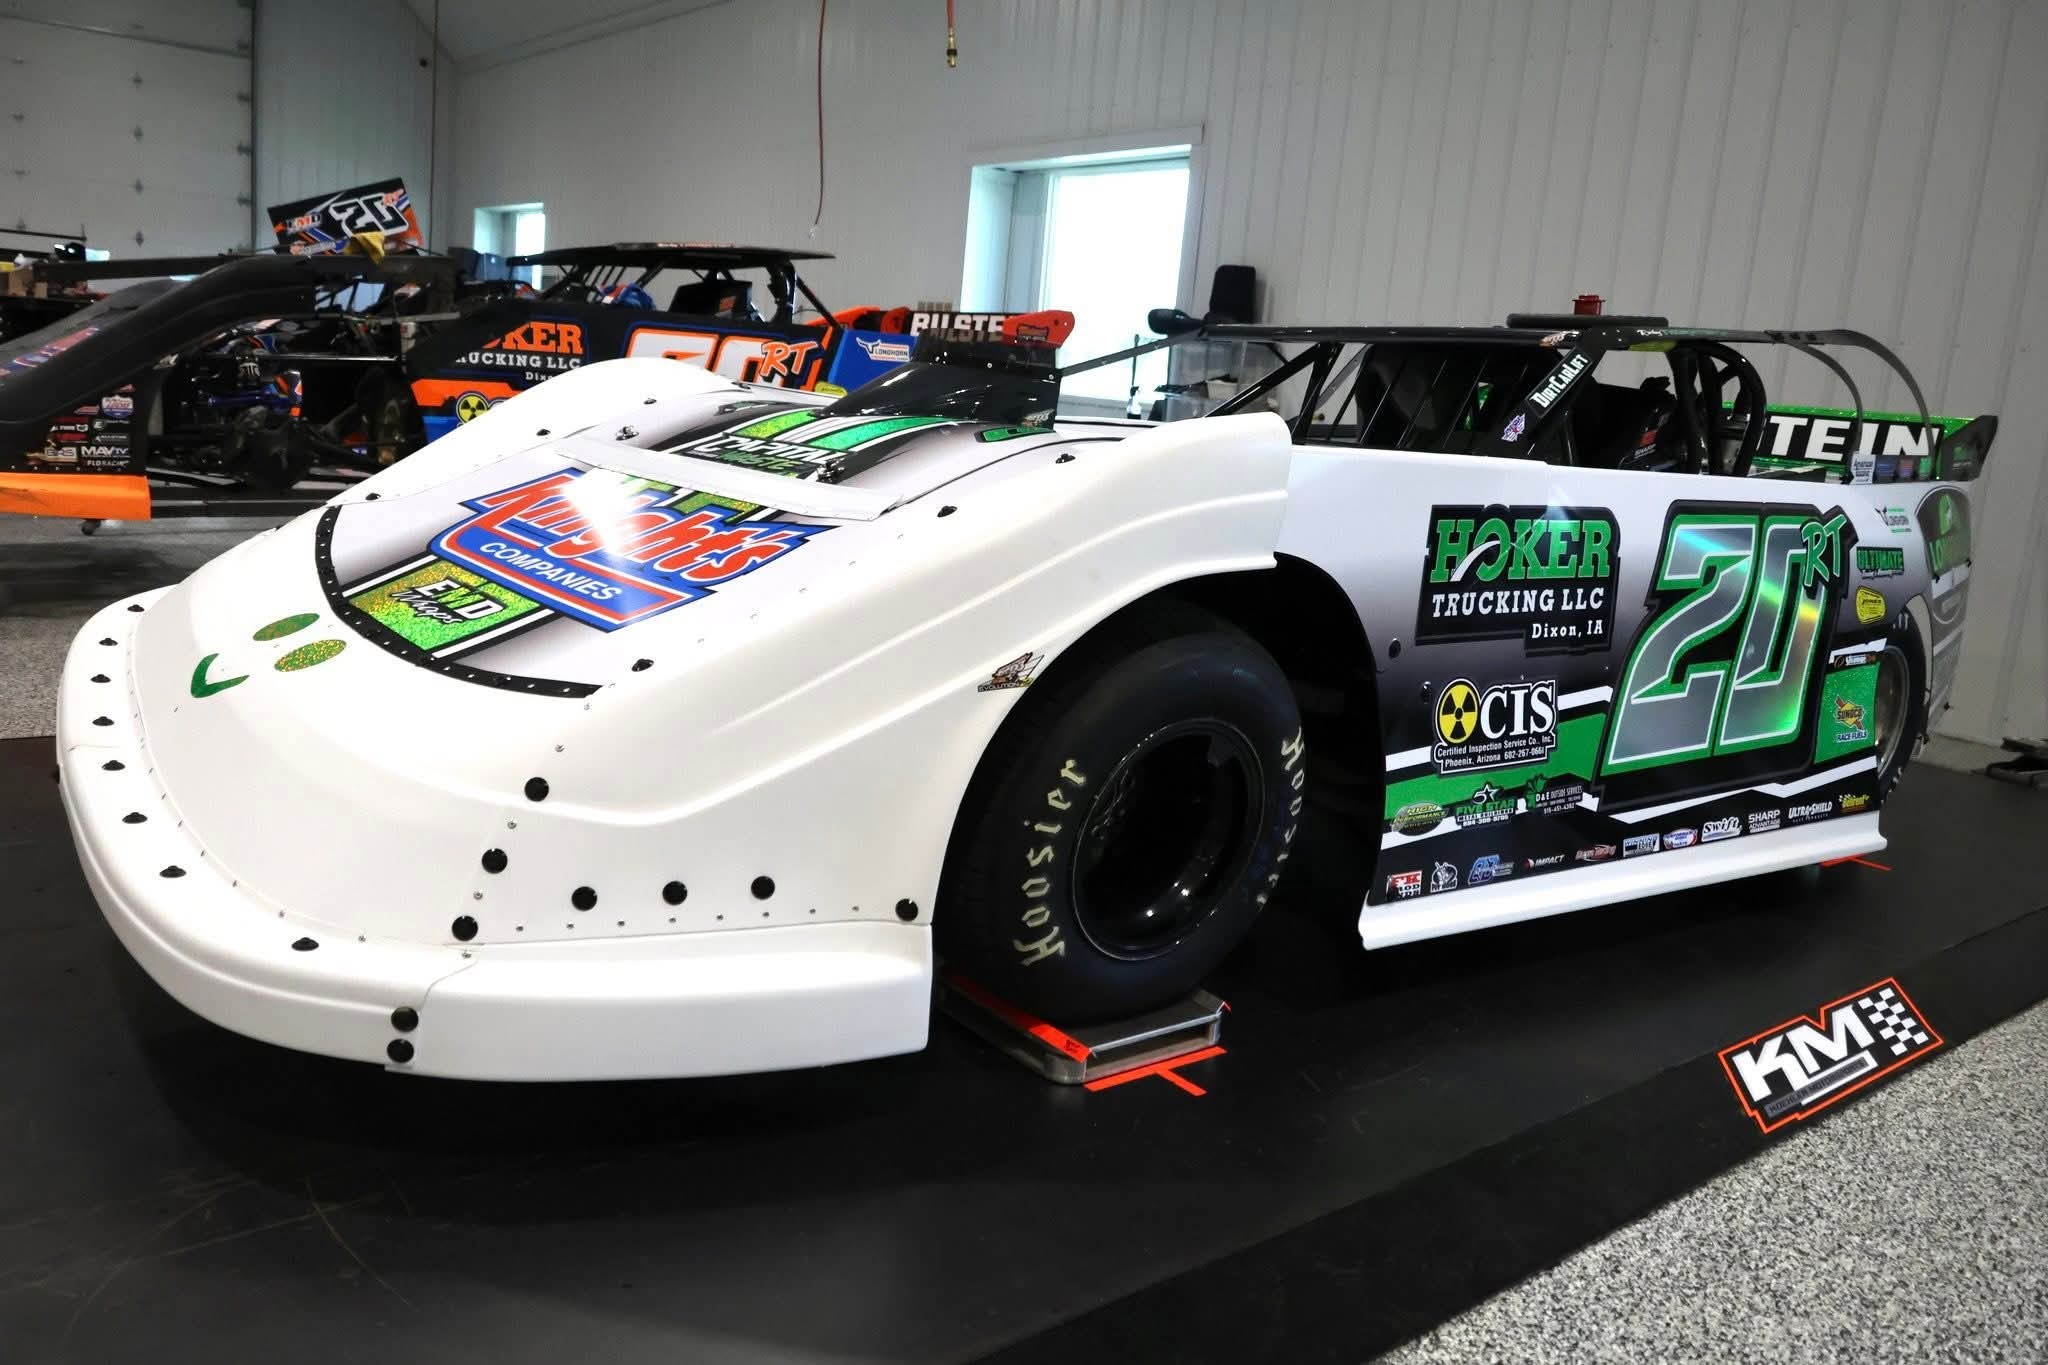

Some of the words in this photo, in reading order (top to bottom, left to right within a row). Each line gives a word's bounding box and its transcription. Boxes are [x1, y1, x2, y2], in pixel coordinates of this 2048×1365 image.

[483, 320, 584, 355] KER
[759, 341, 818, 376] RT
[1758, 415, 1941, 462] TEIN
[1430, 518, 1613, 583] HOKER
[1801, 513, 1847, 587] RT
[480, 542, 622, 601] COMPANIES
[391, 590, 463, 624] Wraps
[414, 579, 504, 619] EMD
[1432, 588, 1555, 617] TRUCKING
[1561, 587, 1604, 611] LLC
[1532, 622, 1582, 639] Dixon,
[1587, 619, 1603, 635] IA
[1602, 513, 1828, 776] 20
[1480, 681, 1555, 740] CIS
[1438, 745, 1467, 757] Certified
[1468, 741, 1502, 754] Inspection
[1503, 738, 1526, 749] Service
[1476, 753, 1501, 764] Arizona
[1749, 809, 1781, 823] SHARP
[1013, 759, 1087, 967] Hoosier
[1535, 854, 1565, 866] IMPACT
[1731, 1003, 1876, 1102] KM
